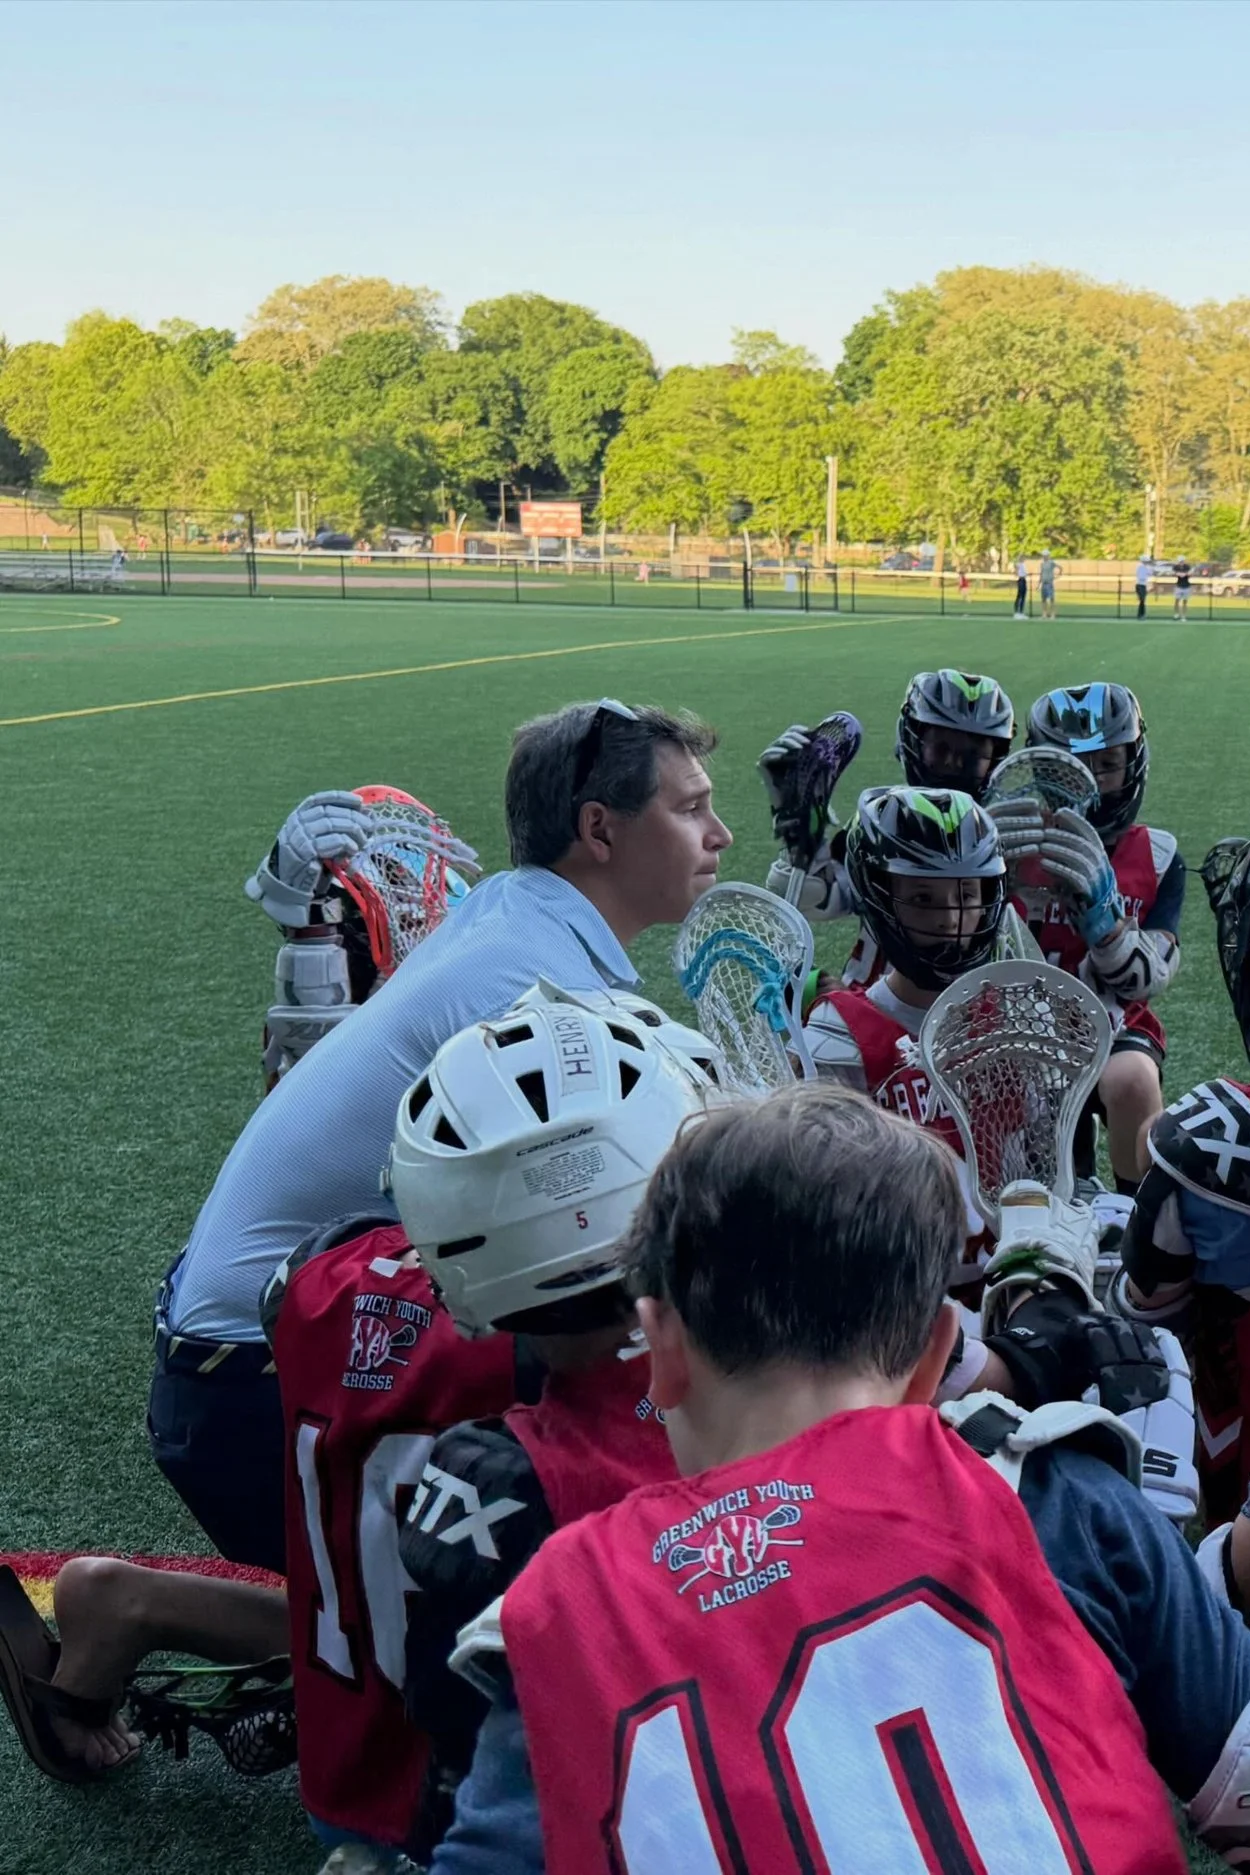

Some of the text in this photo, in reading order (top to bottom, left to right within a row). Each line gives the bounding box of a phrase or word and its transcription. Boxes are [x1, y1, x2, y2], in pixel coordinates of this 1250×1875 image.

[553, 1015, 593, 1077] HENRY
[515, 1126, 594, 1157] cascade
[575, 1210, 588, 1230] 5
[395, 1299, 432, 1329] YOUTH
[652, 1479, 815, 1564] GREENWICH YOUTH
[698, 1560, 792, 1613] LACROSSE
[612, 1592, 1083, 1875] 10
